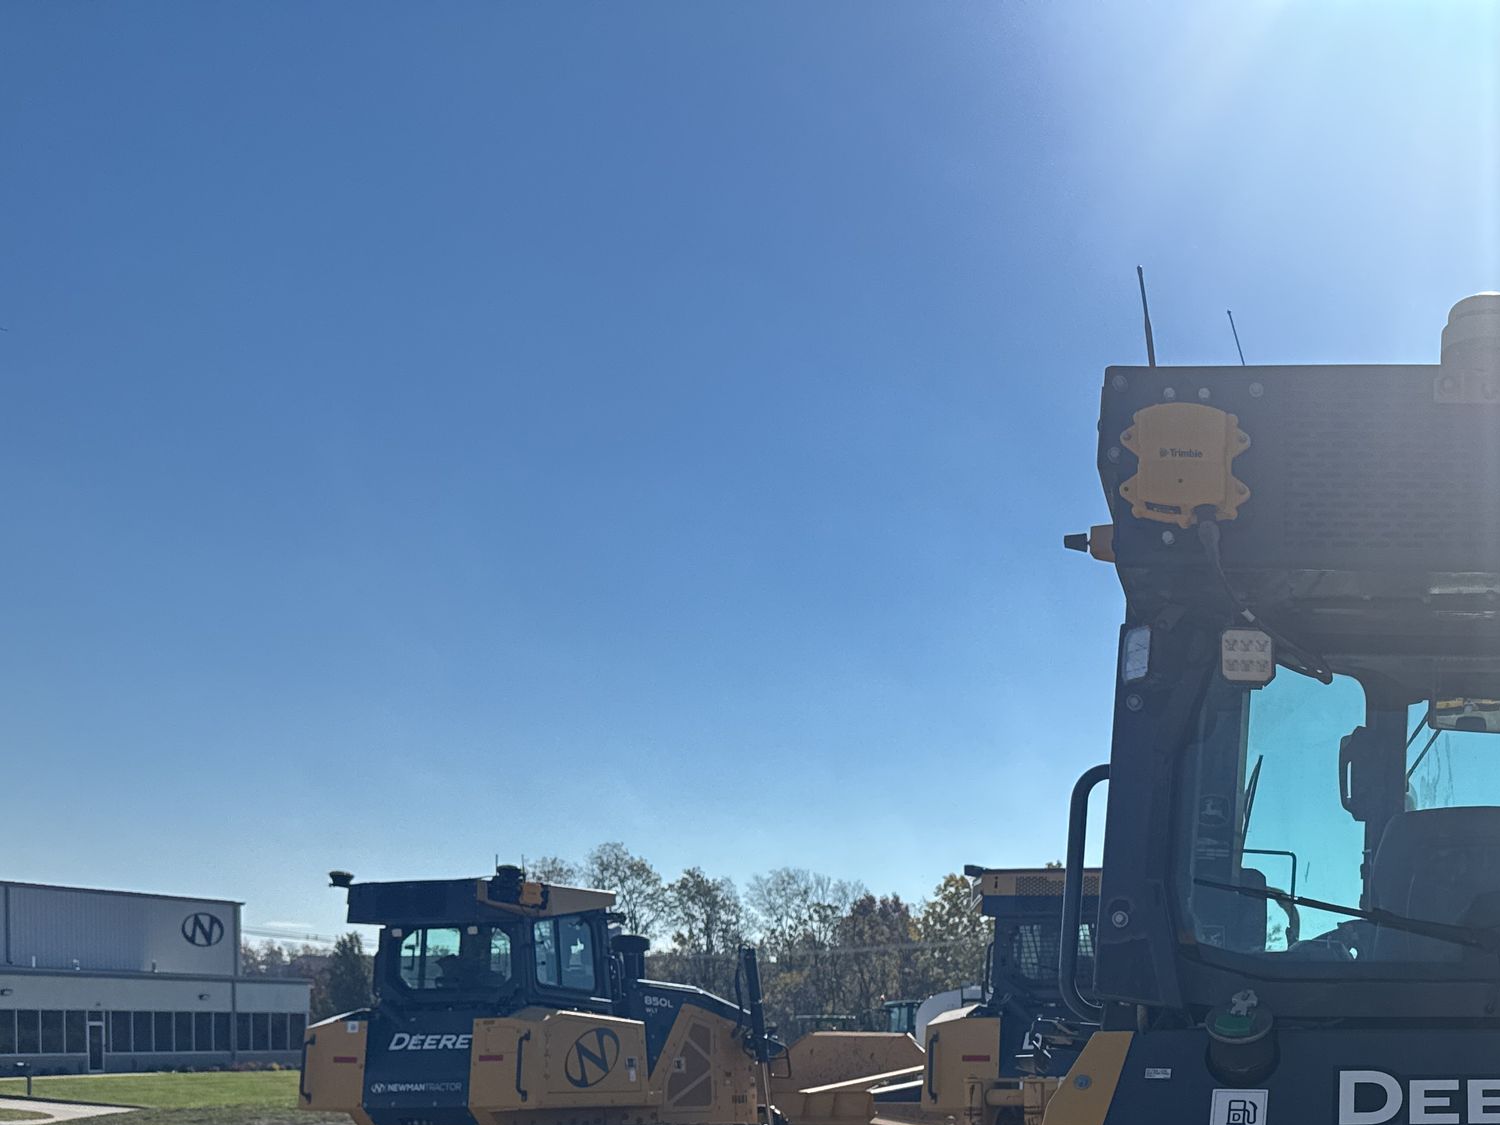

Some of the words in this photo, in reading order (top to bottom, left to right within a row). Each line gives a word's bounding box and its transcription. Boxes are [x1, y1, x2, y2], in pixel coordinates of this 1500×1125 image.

[1169, 448, 1203, 458] Trimble
[644, 995, 674, 1008] 850L
[388, 1032, 473, 1051] DEERE
